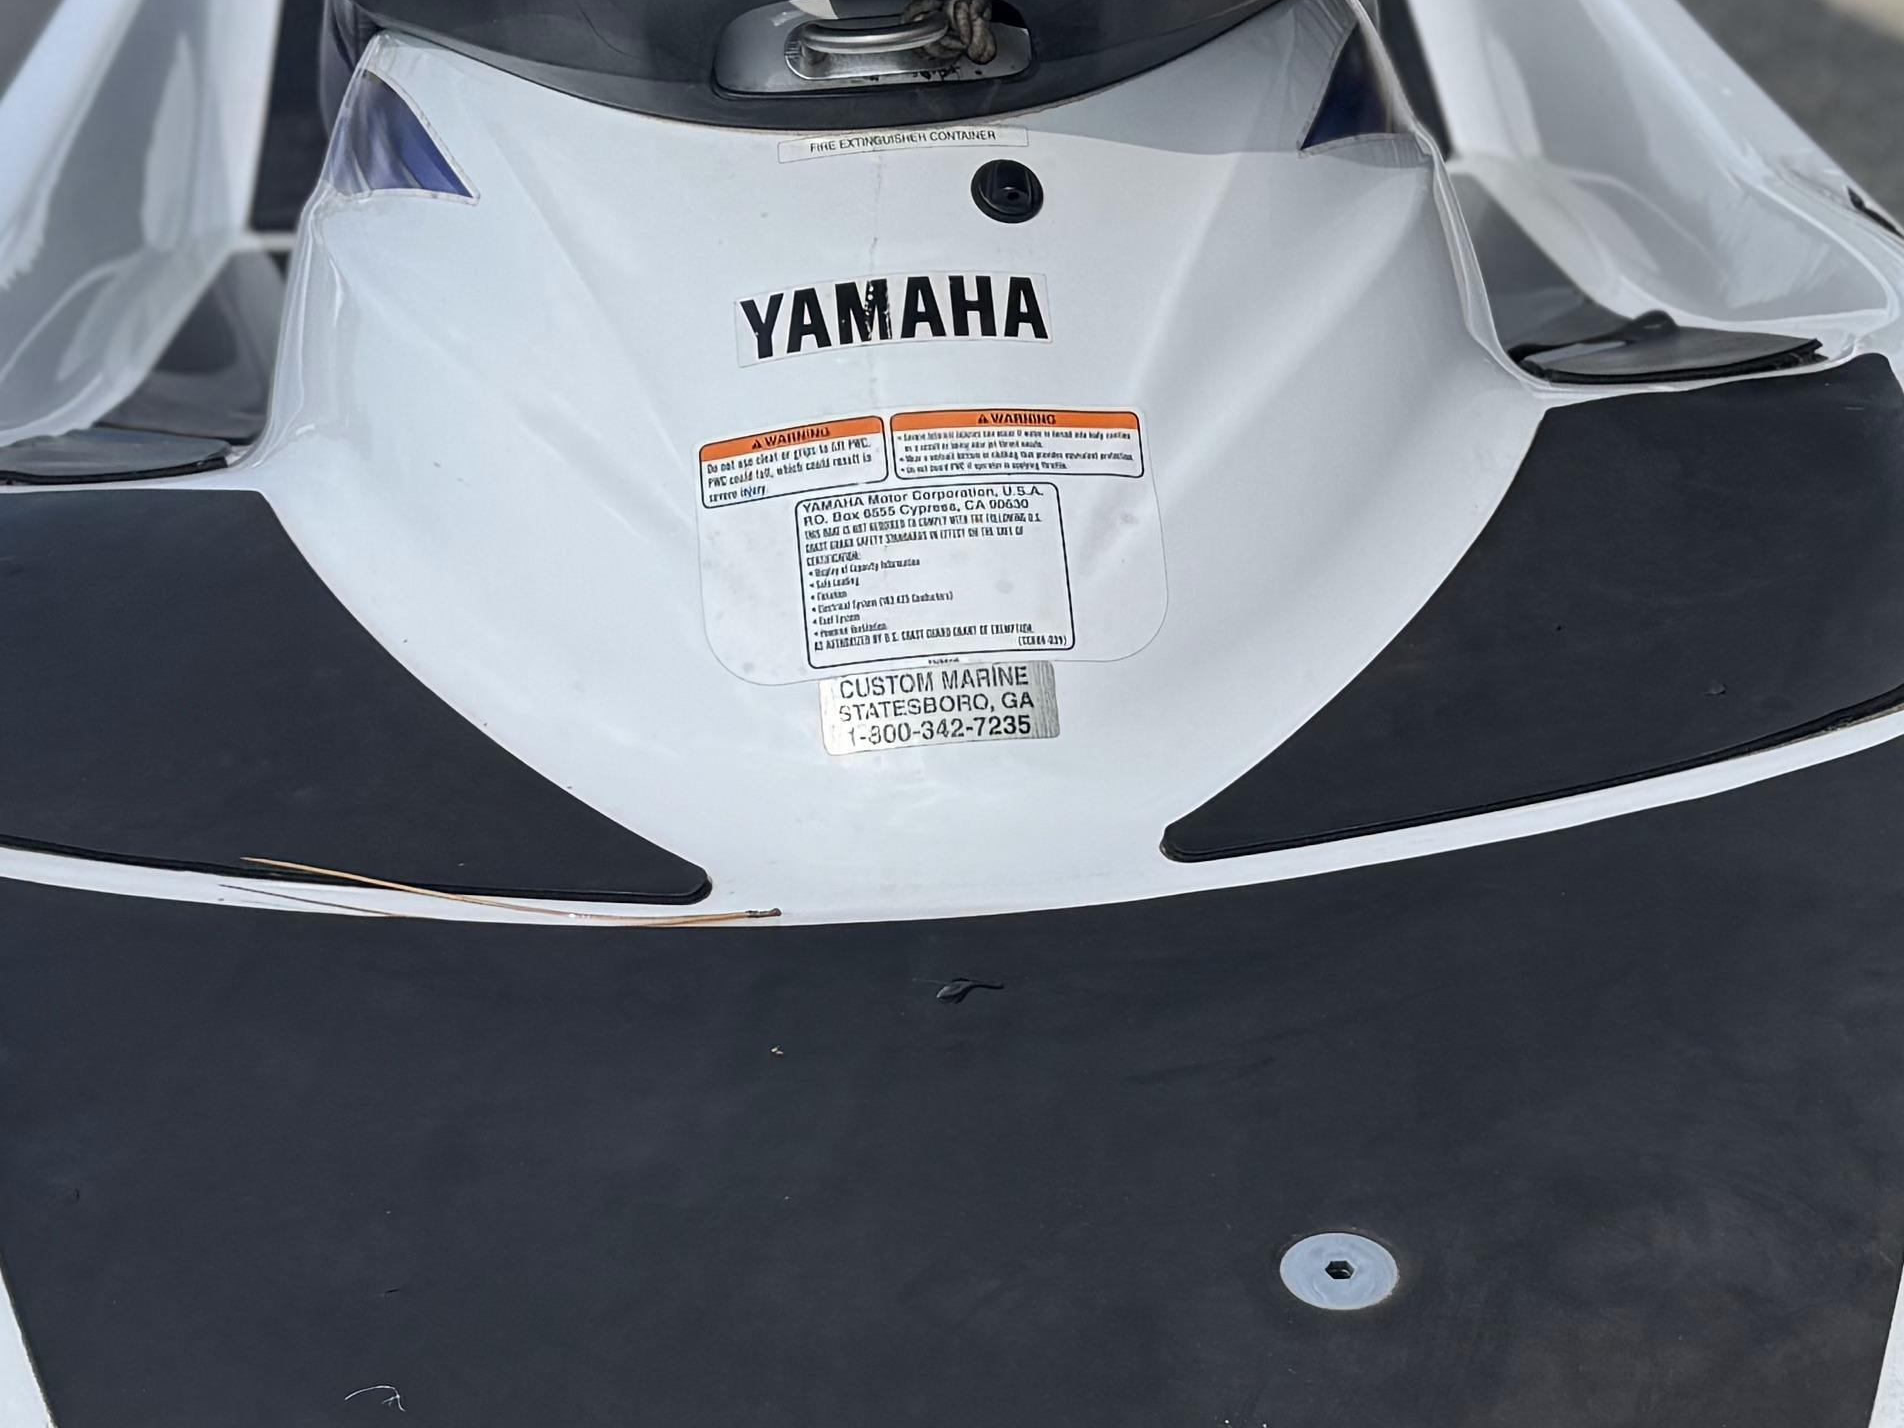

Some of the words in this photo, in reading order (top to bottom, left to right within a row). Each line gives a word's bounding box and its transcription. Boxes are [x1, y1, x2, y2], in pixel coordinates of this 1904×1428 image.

[810, 141, 836, 152] FIRE
[840, 133, 927, 149] EXTINGUISHER
[930, 130, 995, 141] CONTAINER
[740, 275, 1049, 360] YAMAHA
[991, 413, 1056, 425] WARNING
[765, 427, 830, 445] WARNING
[802, 497, 863, 513] YAMAHA
[868, 493, 908, 505] Motor
[912, 487, 999, 502] Corporation,
[832, 510, 860, 523] Box
[899, 502, 960, 517] Cypress,
[964, 500, 986, 511] CA
[840, 671, 934, 699] CUSTOM
[941, 666, 1029, 688] MARINE
[839, 693, 995, 722] STATESBORO,
[1002, 691, 1034, 709] GA
[848, 715, 1031, 746] 1-800-342-7235
